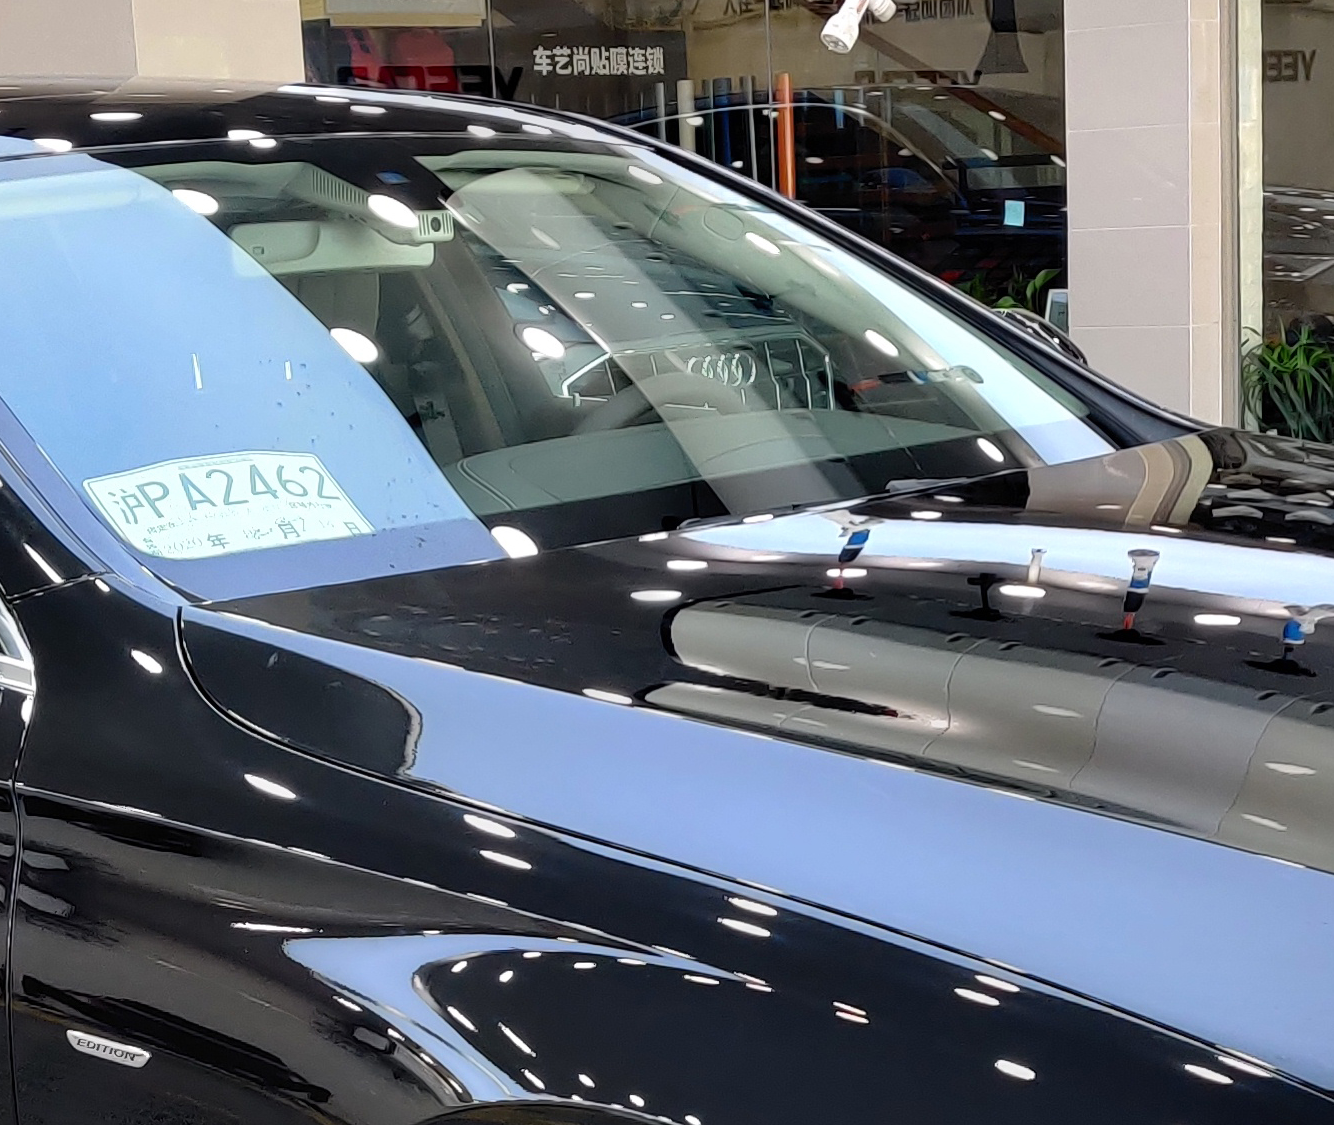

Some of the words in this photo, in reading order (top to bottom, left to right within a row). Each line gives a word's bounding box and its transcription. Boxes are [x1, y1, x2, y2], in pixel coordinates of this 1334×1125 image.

[533, 45, 665, 76] 车艺尚贴膜连锁
[76, 1038, 136, 1061] EDITION
